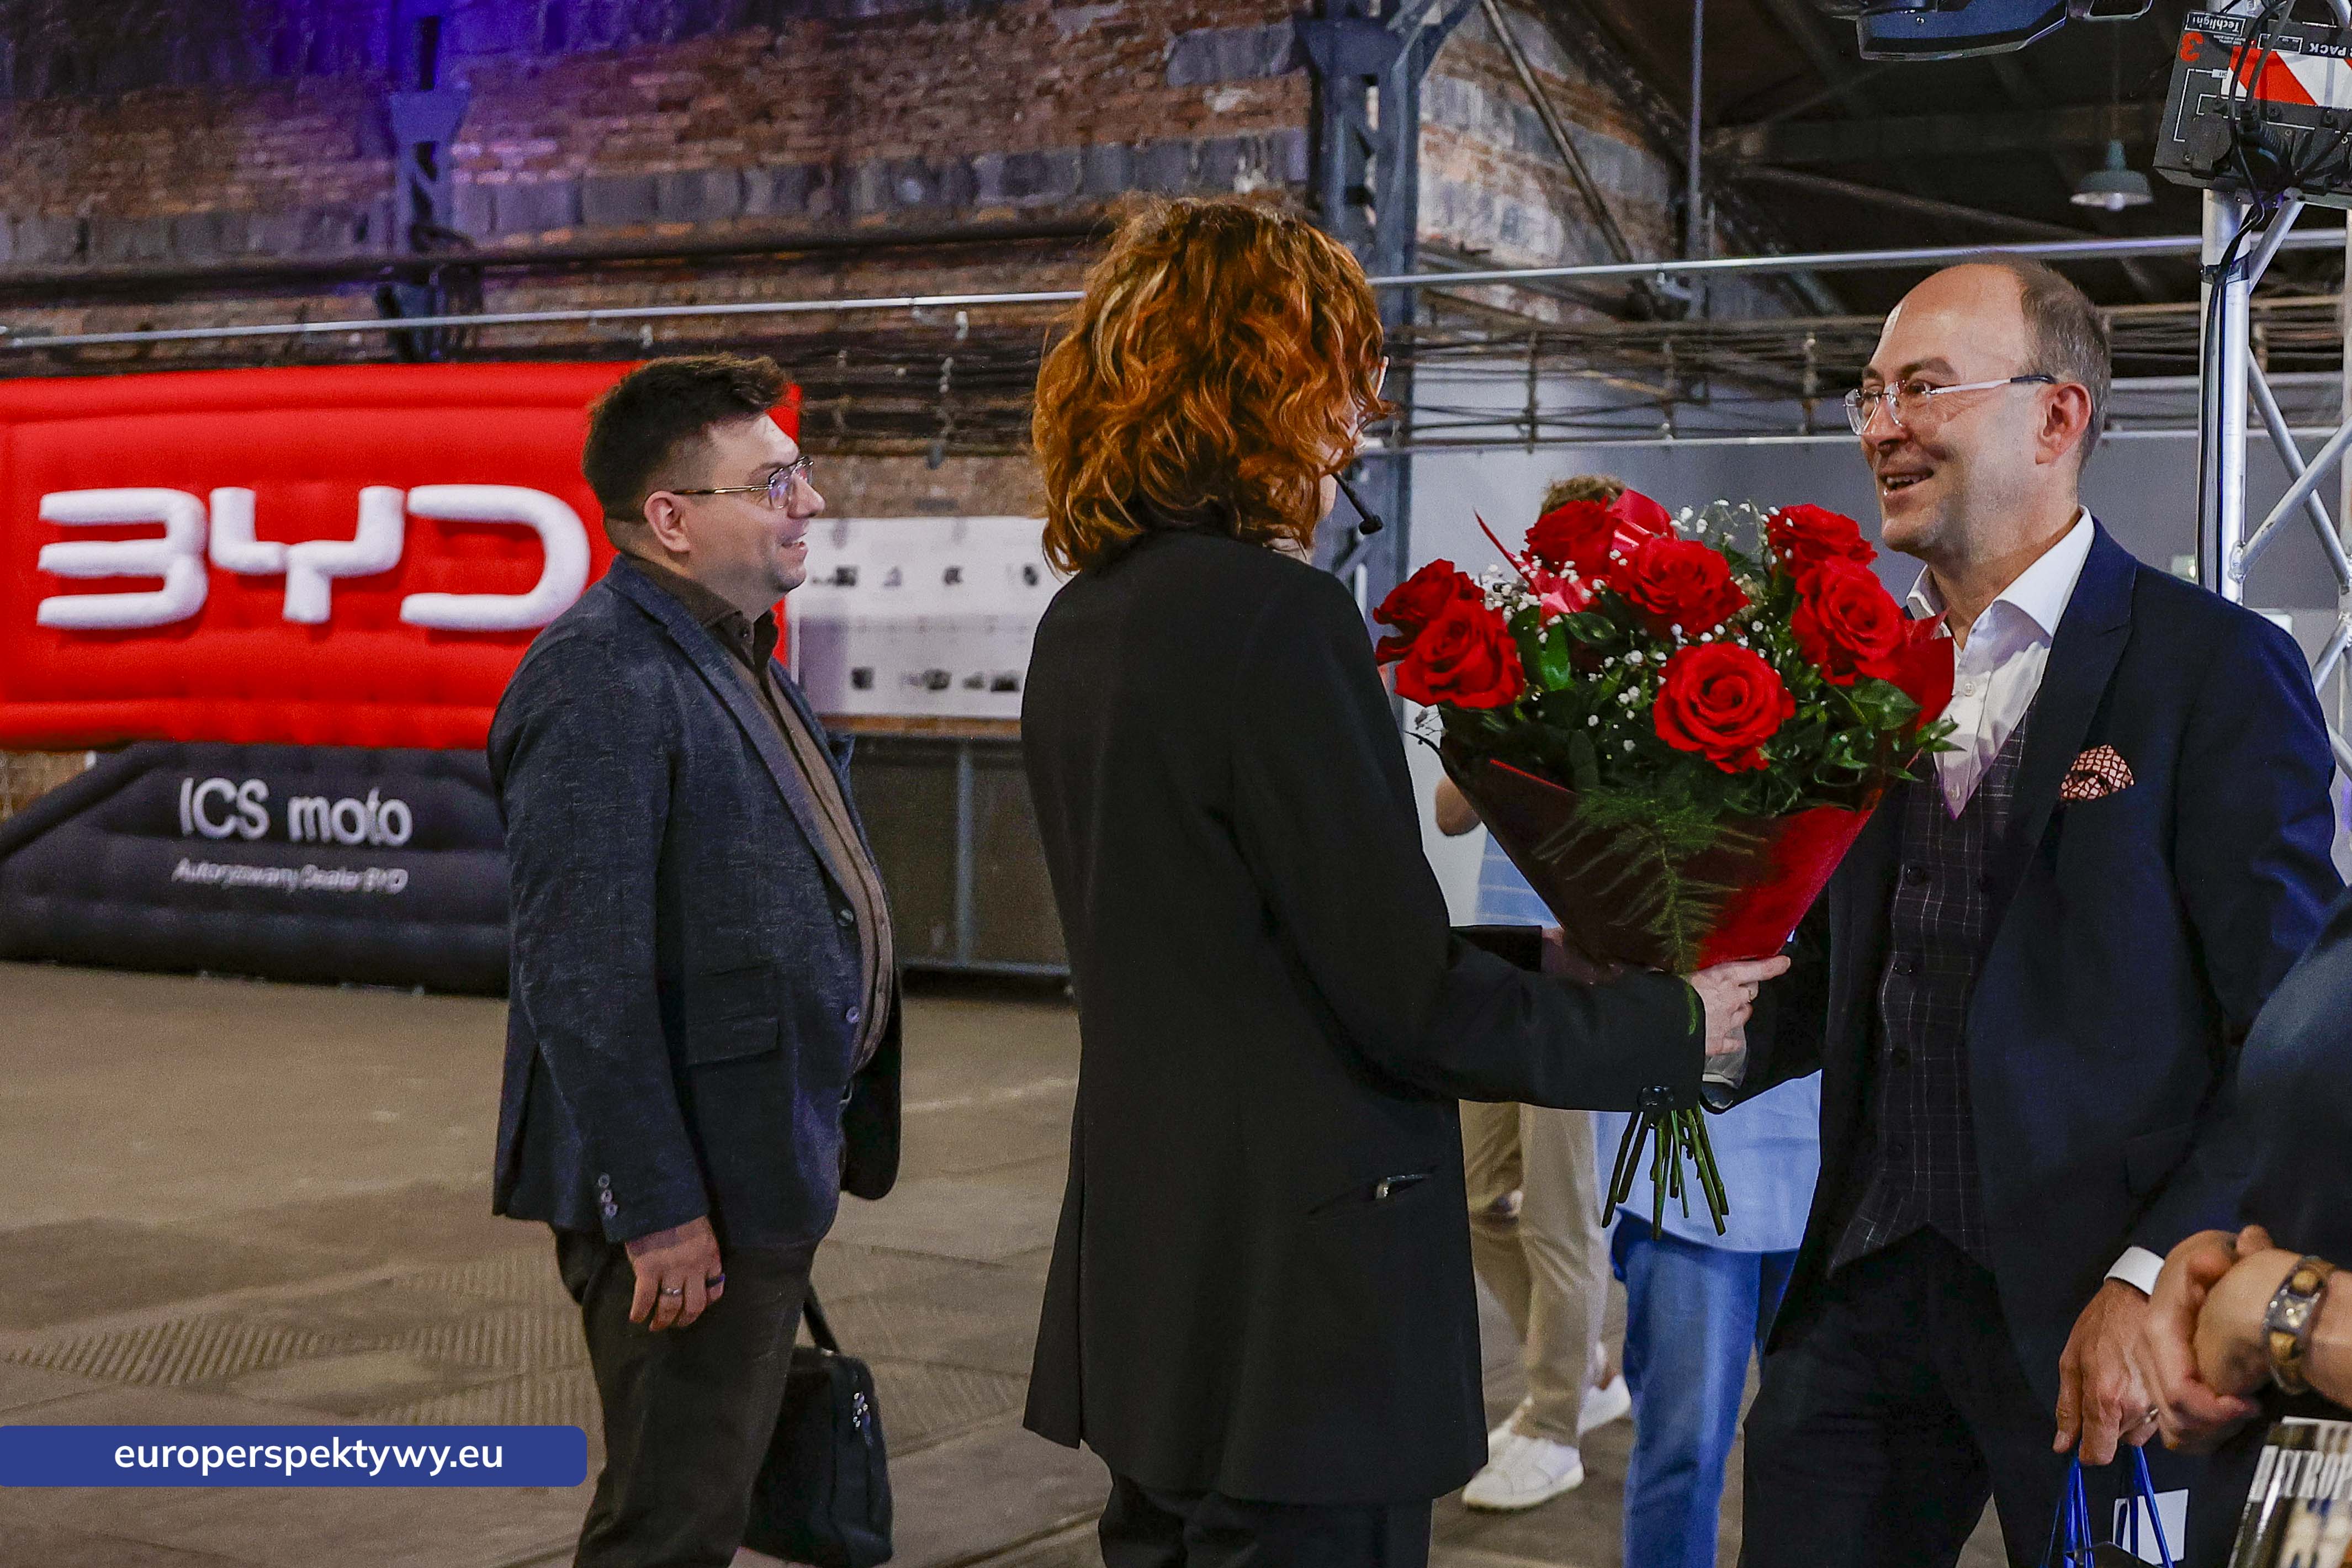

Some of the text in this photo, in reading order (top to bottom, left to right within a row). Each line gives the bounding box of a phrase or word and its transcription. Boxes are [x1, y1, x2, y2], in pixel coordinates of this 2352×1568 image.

[2180, 32, 2203, 62] 3
[2309, 43, 2346, 56] PACK
[36, 484, 590, 632] BYD
[179, 777, 413, 846] ICS moto
